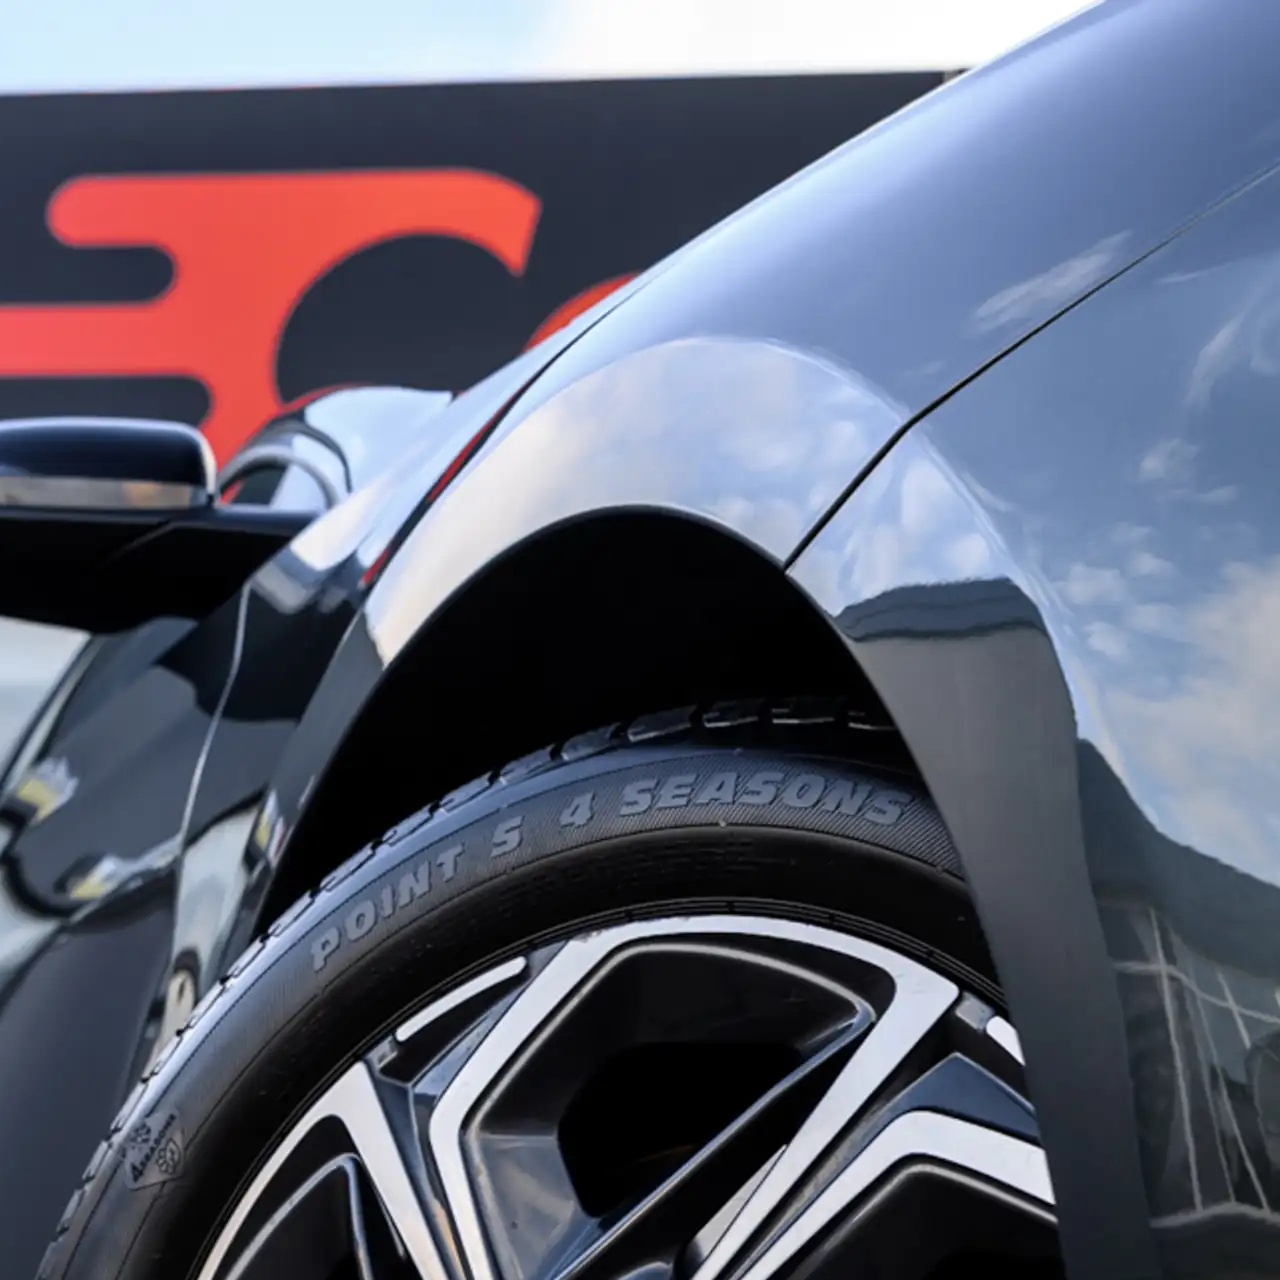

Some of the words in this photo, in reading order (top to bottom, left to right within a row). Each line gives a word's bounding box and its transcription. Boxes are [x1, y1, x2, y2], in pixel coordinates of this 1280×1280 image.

[311, 843, 466, 972] POINT
[489, 815, 525, 858] S
[558, 791, 596, 828] 4
[619, 770, 912, 826] SEASONS
